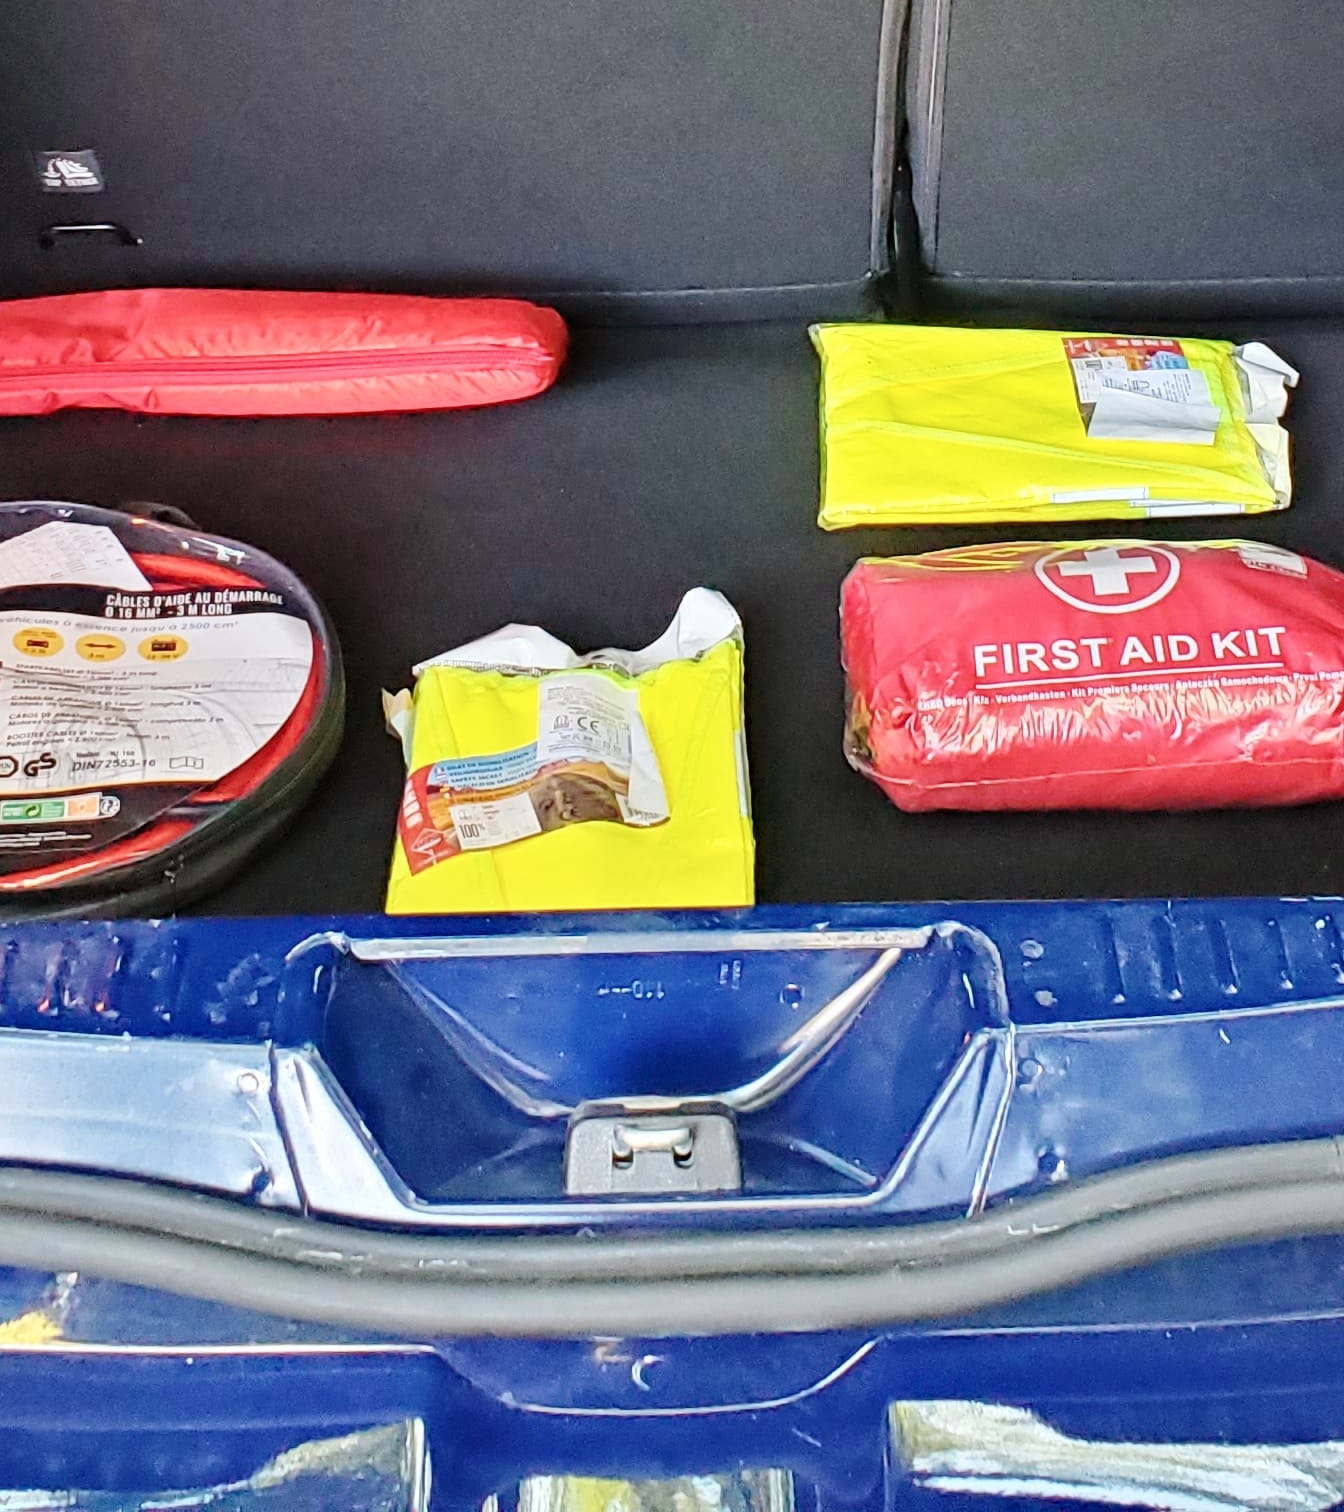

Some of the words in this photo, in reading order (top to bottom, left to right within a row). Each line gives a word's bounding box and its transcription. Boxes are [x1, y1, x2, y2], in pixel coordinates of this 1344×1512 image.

[154, 592, 192, 607] D'AIDE
[195, 591, 211, 604] AU
[214, 588, 283, 605] DÉMARRAGE
[119, 607, 132, 618] 16
[177, 604, 185, 616] 3
[188, 604, 198, 616] M
[201, 603, 232, 615] LONG
[181, 621, 210, 630] 2500
[973, 638, 1108, 677] FIRST
[1119, 634, 1199, 666] AID
[1211, 626, 1286, 659] KIT
